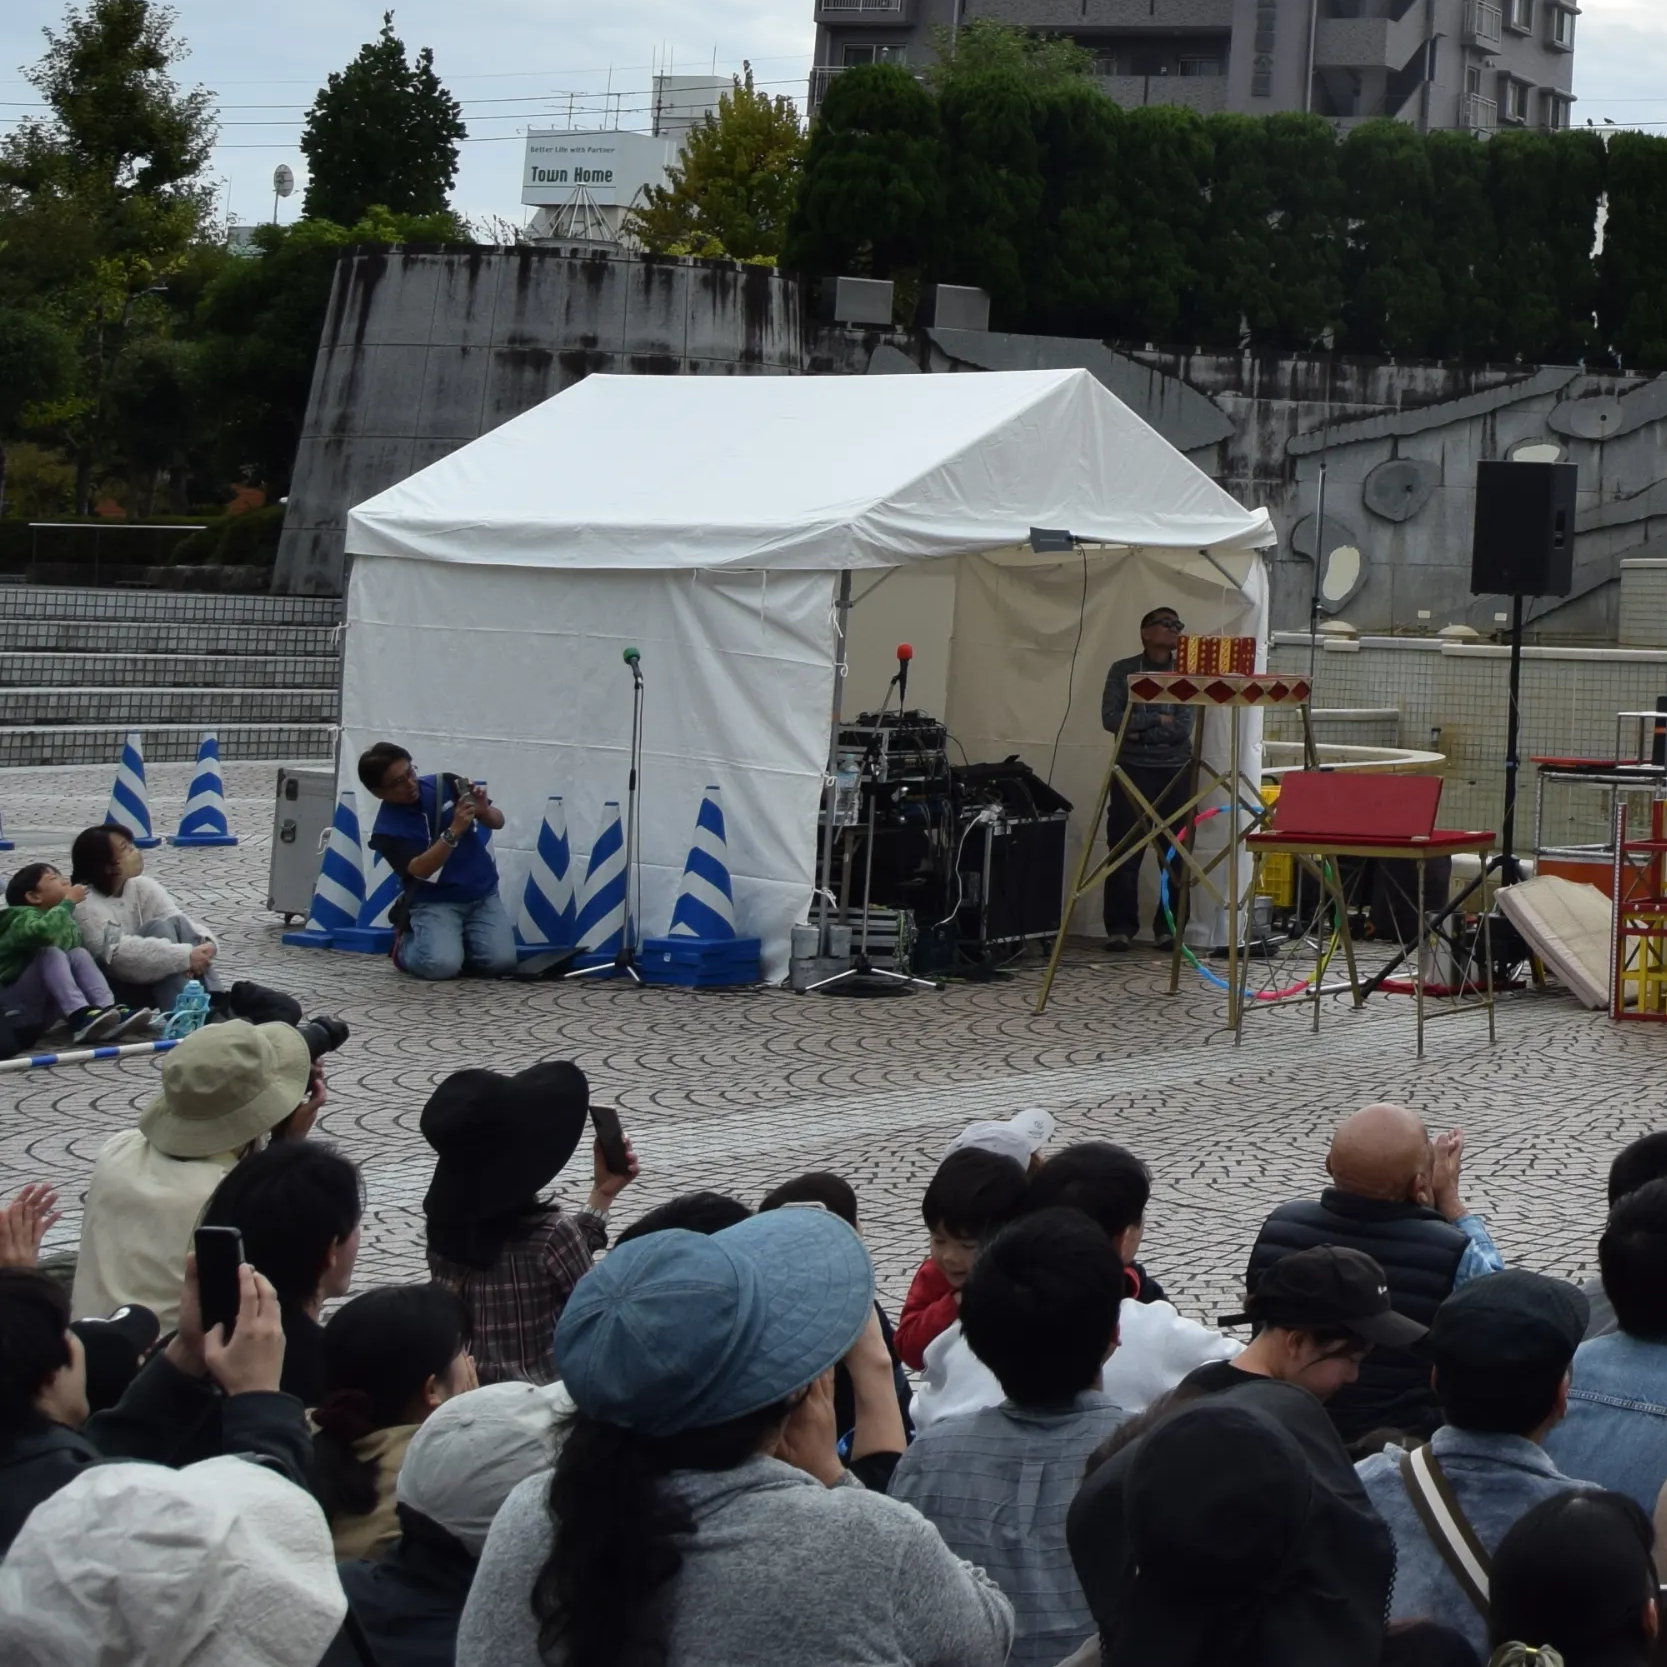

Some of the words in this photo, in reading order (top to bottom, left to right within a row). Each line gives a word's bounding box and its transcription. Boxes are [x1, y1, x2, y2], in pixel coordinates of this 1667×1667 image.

[587, 146, 616, 154] Partner
[531, 166, 568, 182] Town
[573, 166, 613, 183] Home
